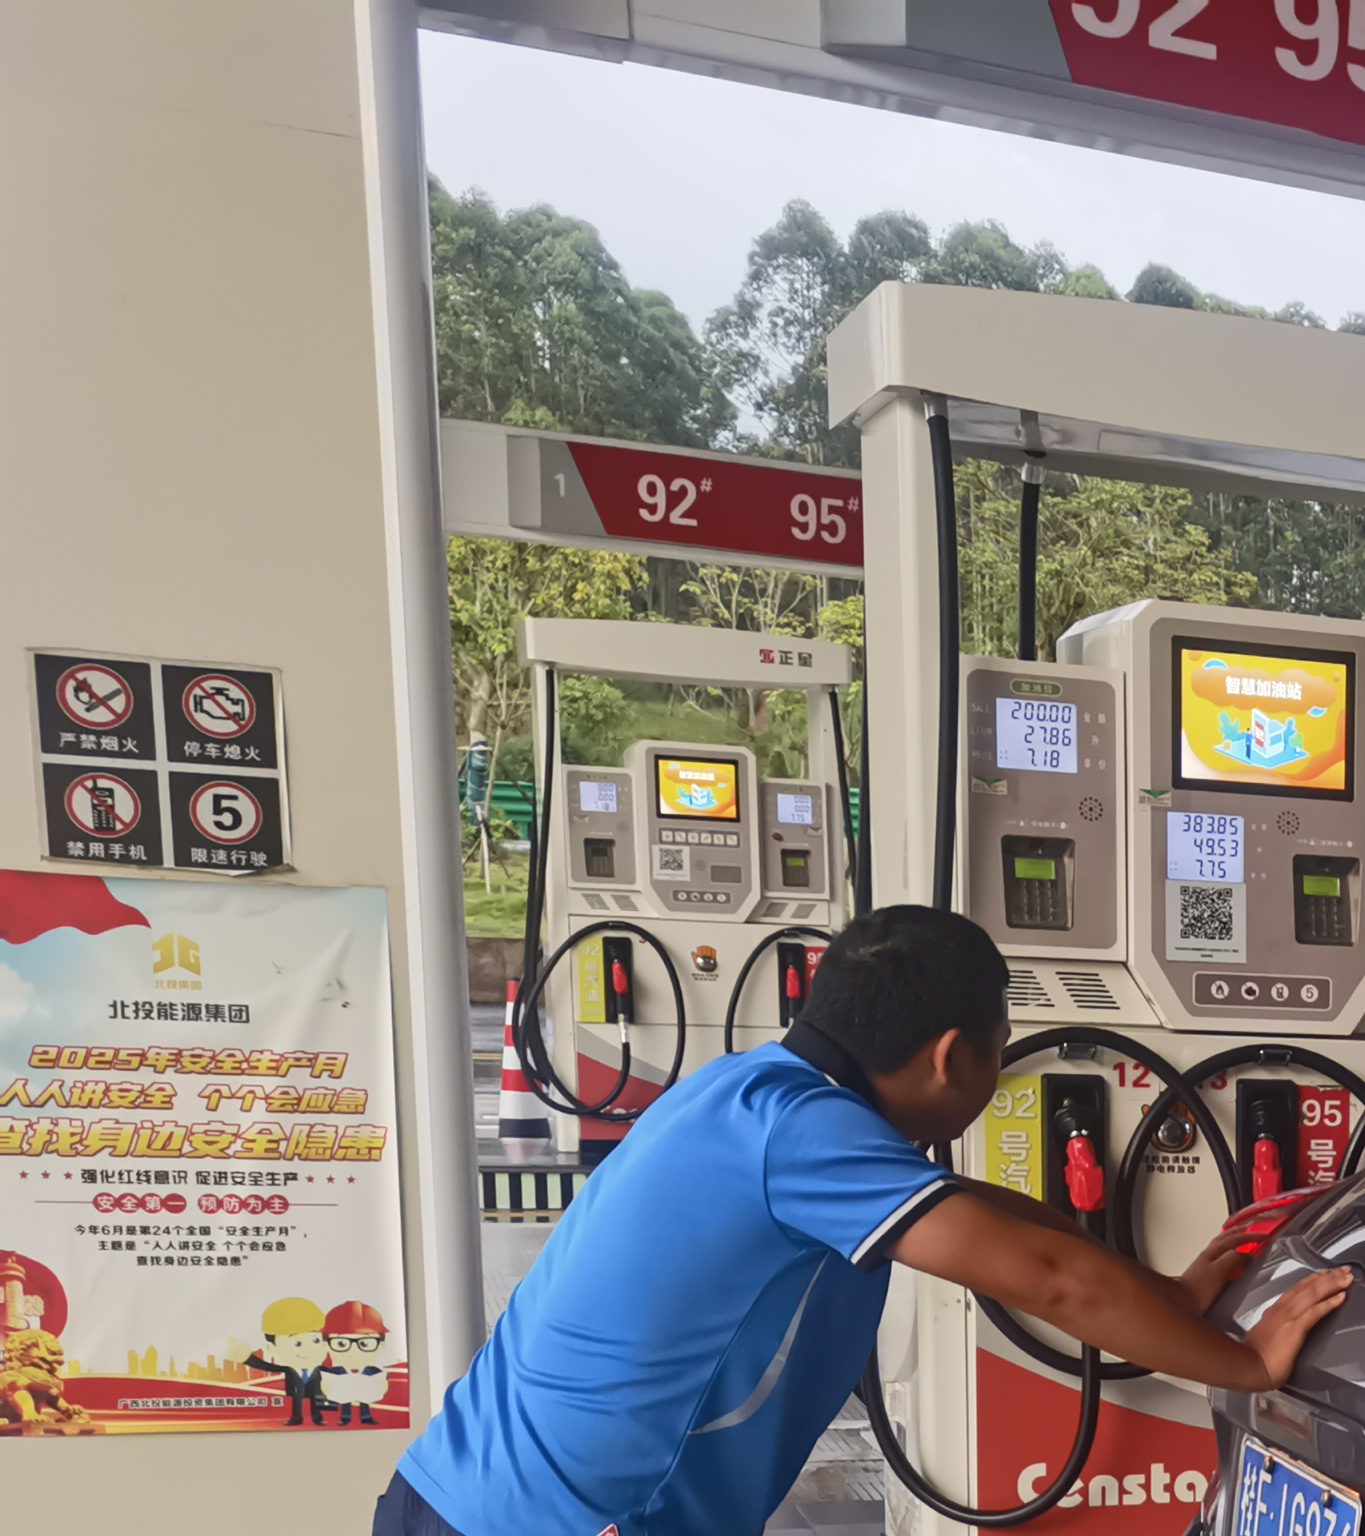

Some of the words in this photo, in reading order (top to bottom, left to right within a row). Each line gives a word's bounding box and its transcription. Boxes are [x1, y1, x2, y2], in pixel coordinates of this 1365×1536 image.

[553, 473, 566, 498] 1
[1225, 675, 1302, 700] 智慧加油站
[1011, 701, 1072, 724] 200.00
[58, 731, 140, 754] 严禁烟火
[1024, 725, 1072, 747] 27.86
[183, 741, 262, 762] 停车熄火
[1027, 748, 1060, 768] 7.18
[212, 793, 243, 832] 5
[1182, 814, 1239, 835] 383.85
[66, 840, 148, 861] 禁用手机
[190, 847, 269, 867] 限速行驶
[1194, 838, 1239, 858] 49.53
[1195, 859, 1227, 879] 7.75
[108, 1000, 251, 1024] 北投能源集团
[28, 1044, 349, 1079] 2025年安全生产月
[1113, 1061, 1152, 1088] 12
[0, 1078, 178, 1110] 人人讲安全
[198, 1083, 369, 1115] 个个会应急
[991, 1089, 1036, 1119] 92
[1301, 1099, 1342, 1127] 95
[0, 1115, 388, 1162] 查找身边安全隐患
[80, 1168, 189, 1185] 强化红线意识
[195, 1170, 299, 1187] 促进安全生产
[97, 1195, 185, 1211] 安全第一
[199, 1196, 286, 1212] 预防为主
[1017, 1462, 1217, 1508] Censta
